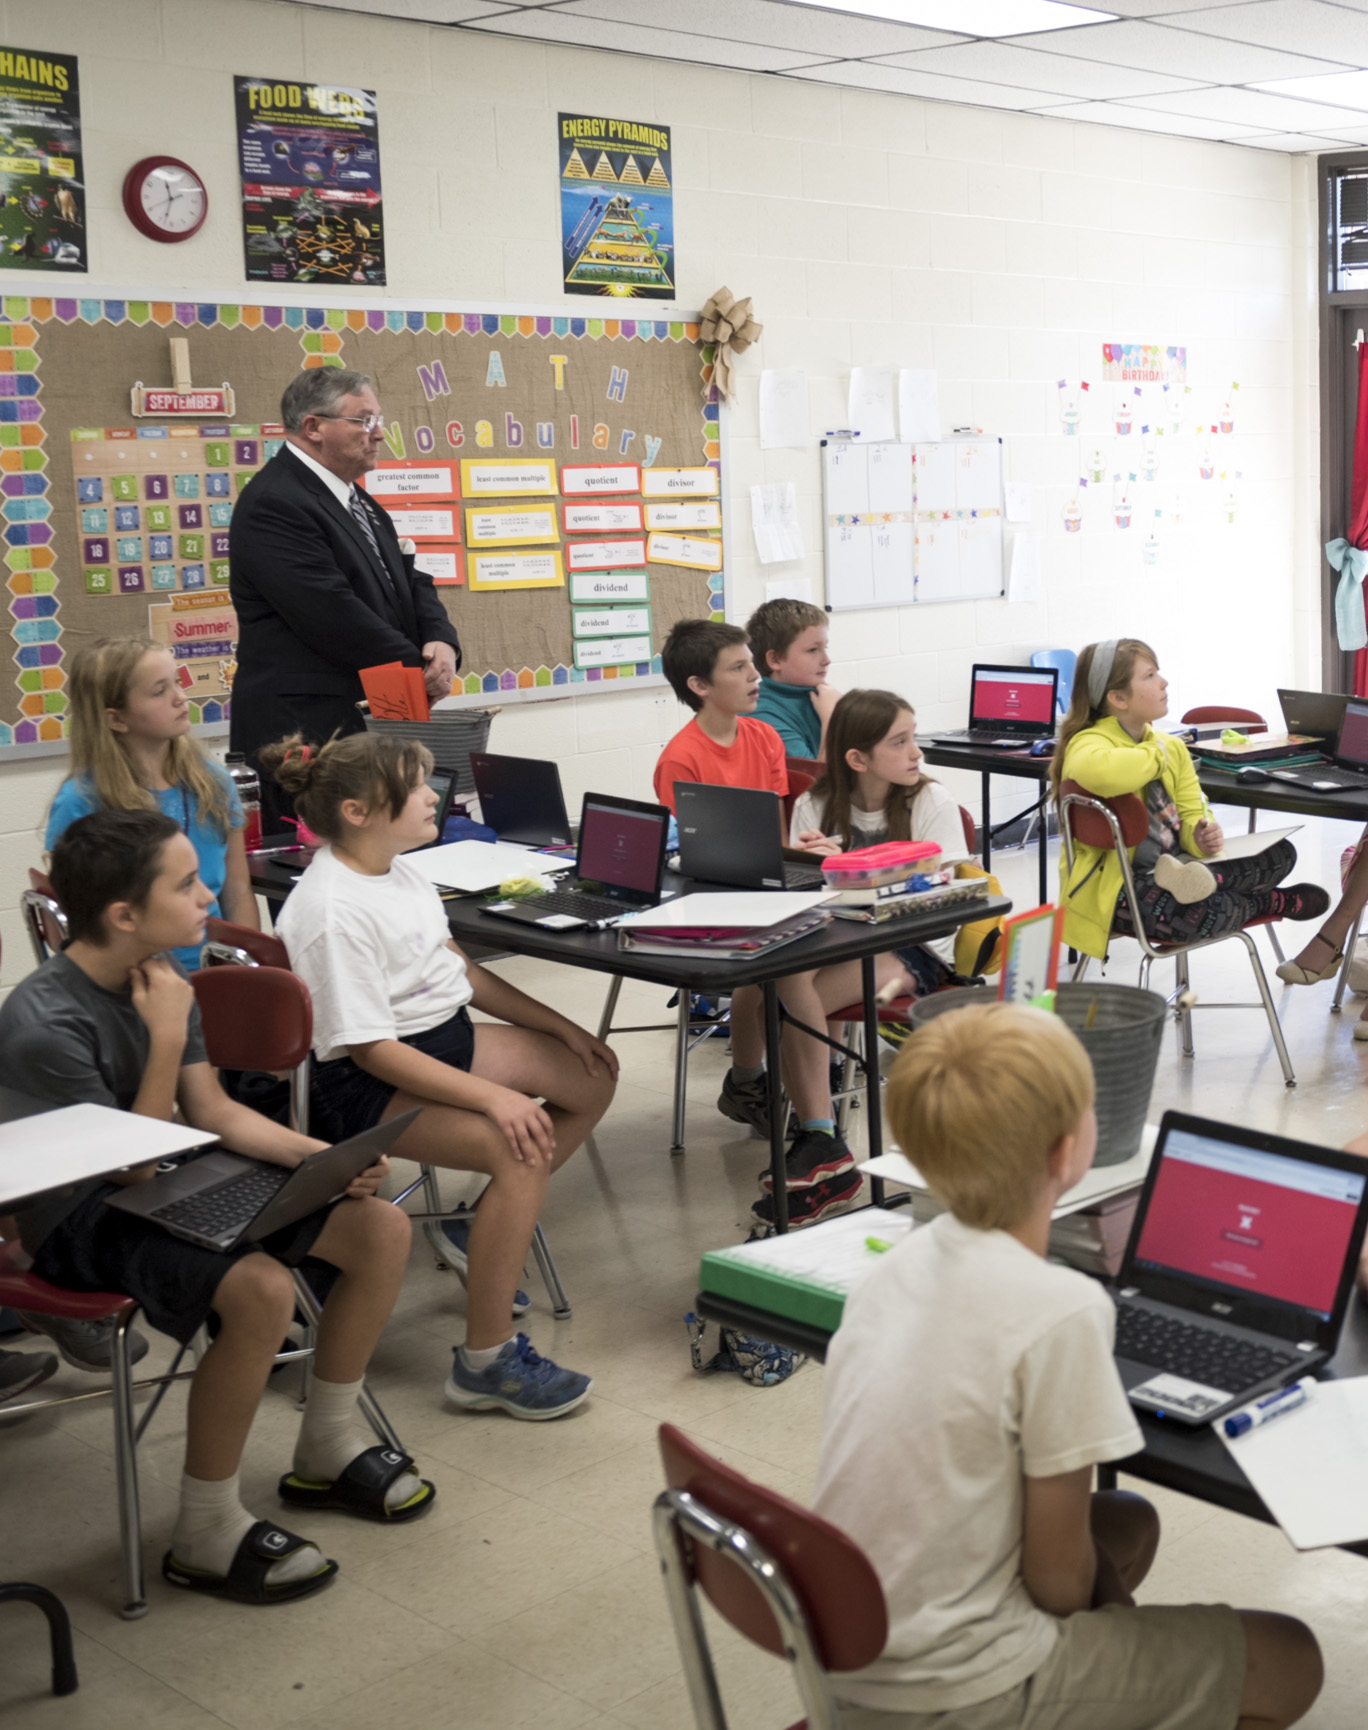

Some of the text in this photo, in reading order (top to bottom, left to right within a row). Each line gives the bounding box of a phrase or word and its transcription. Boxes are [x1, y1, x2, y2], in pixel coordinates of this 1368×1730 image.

[249, 84, 365, 118] FOOD WEBS
[562, 119, 606, 138] ENERGY
[609, 120, 668, 151] PYRAMIDS
[1124, 356, 1165, 370] HAPPY
[416, 350, 630, 402] MATH
[1122, 370, 1170, 381] BIRTHDAY!
[149, 394, 219, 410] SEPTEMBER
[382, 412, 662, 468] Vocabulary
[215, 448, 221, 461] 1
[243, 446, 251, 459] 2
[377, 472, 406, 482] greatest
[476, 475, 488, 483] least
[520, 474, 546, 483] multiple
[585, 476, 618, 486] quotient
[86, 479, 222, 497] 4 5 6 7 8
[397, 483, 420, 491] factor
[667, 479, 695, 487] divisor
[90, 508, 227, 527] 11 12 13 14 15
[573, 514, 600, 522] quotient
[91, 538, 229, 558] 18 19 20 21 22
[573, 552, 594, 560] quotient
[92, 566, 230, 587] 25 26 27 28 29
[593, 583, 628, 592] dividend
[177, 598, 189, 606] The
[580, 619, 609, 627] dividend
[176, 621, 230, 638] Summer
[177, 646, 189, 654] The
[192, 644, 220, 653] weather
[197, 673, 210, 681] and
